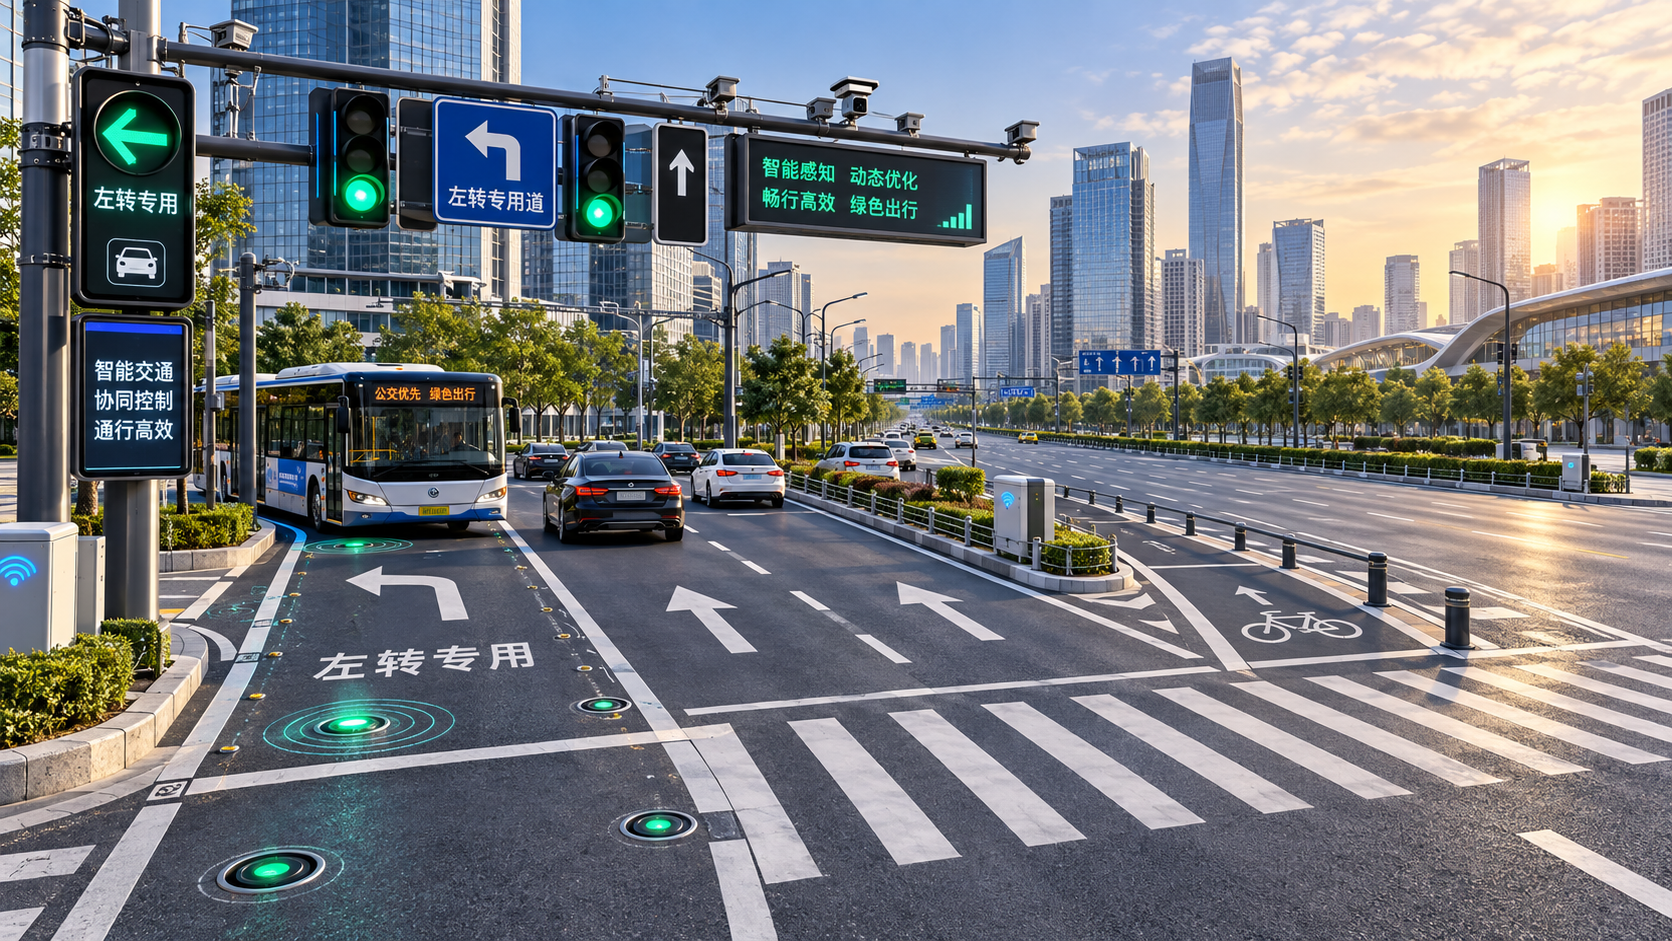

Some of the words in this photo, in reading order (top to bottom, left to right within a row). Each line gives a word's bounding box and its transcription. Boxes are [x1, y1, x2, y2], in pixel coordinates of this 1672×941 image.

[762, 157, 835, 183] 智能感知
[850, 166, 918, 191] 动态优化
[93, 186, 178, 215] 左转专用
[448, 185, 544, 213] 左转专用道
[762, 187, 836, 213] 畅行高效
[850, 194, 918, 220] 绿色出行
[94, 359, 174, 382] 智能交通
[94, 389, 173, 412] 协同控制
[375, 387, 421, 401] 公交优先
[94, 419, 174, 441] 通行高效
[313, 642, 535, 681] 左转专用
